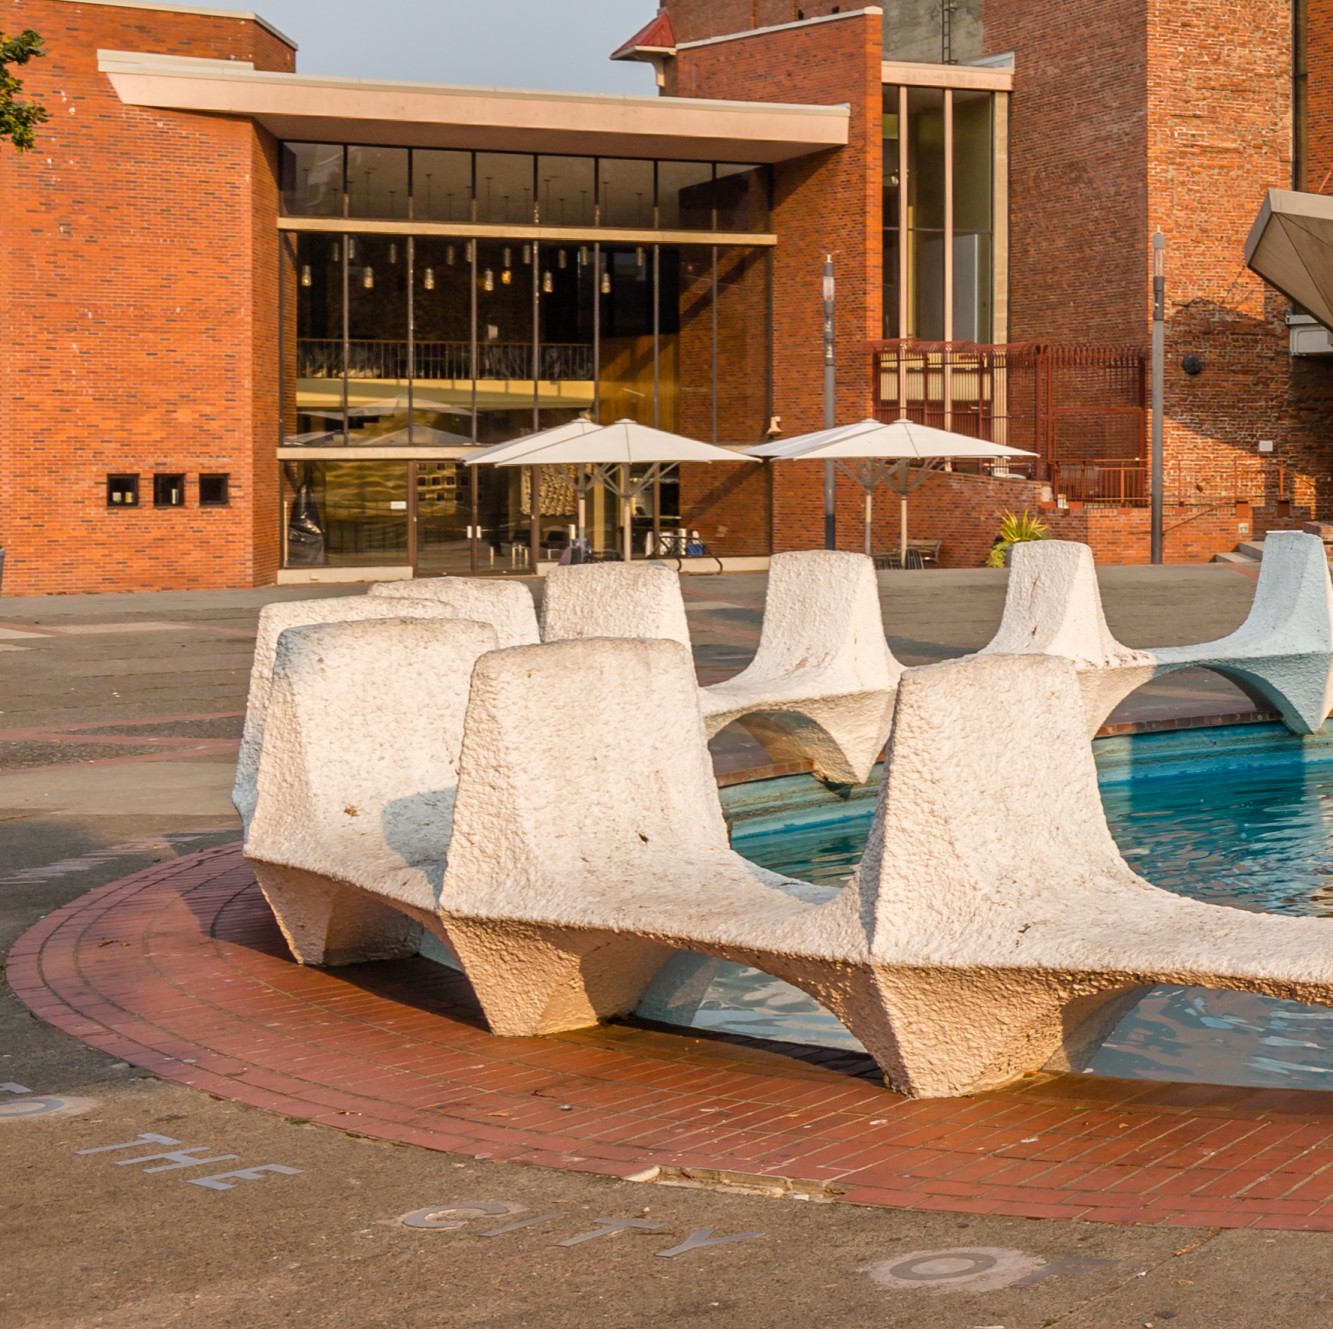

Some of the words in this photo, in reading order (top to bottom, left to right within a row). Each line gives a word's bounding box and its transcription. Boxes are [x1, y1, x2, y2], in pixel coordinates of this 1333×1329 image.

[75, 1132, 305, 1191] THE
[402, 1202, 767, 1258] CITY
[889, 1252, 1122, 1288] OF
